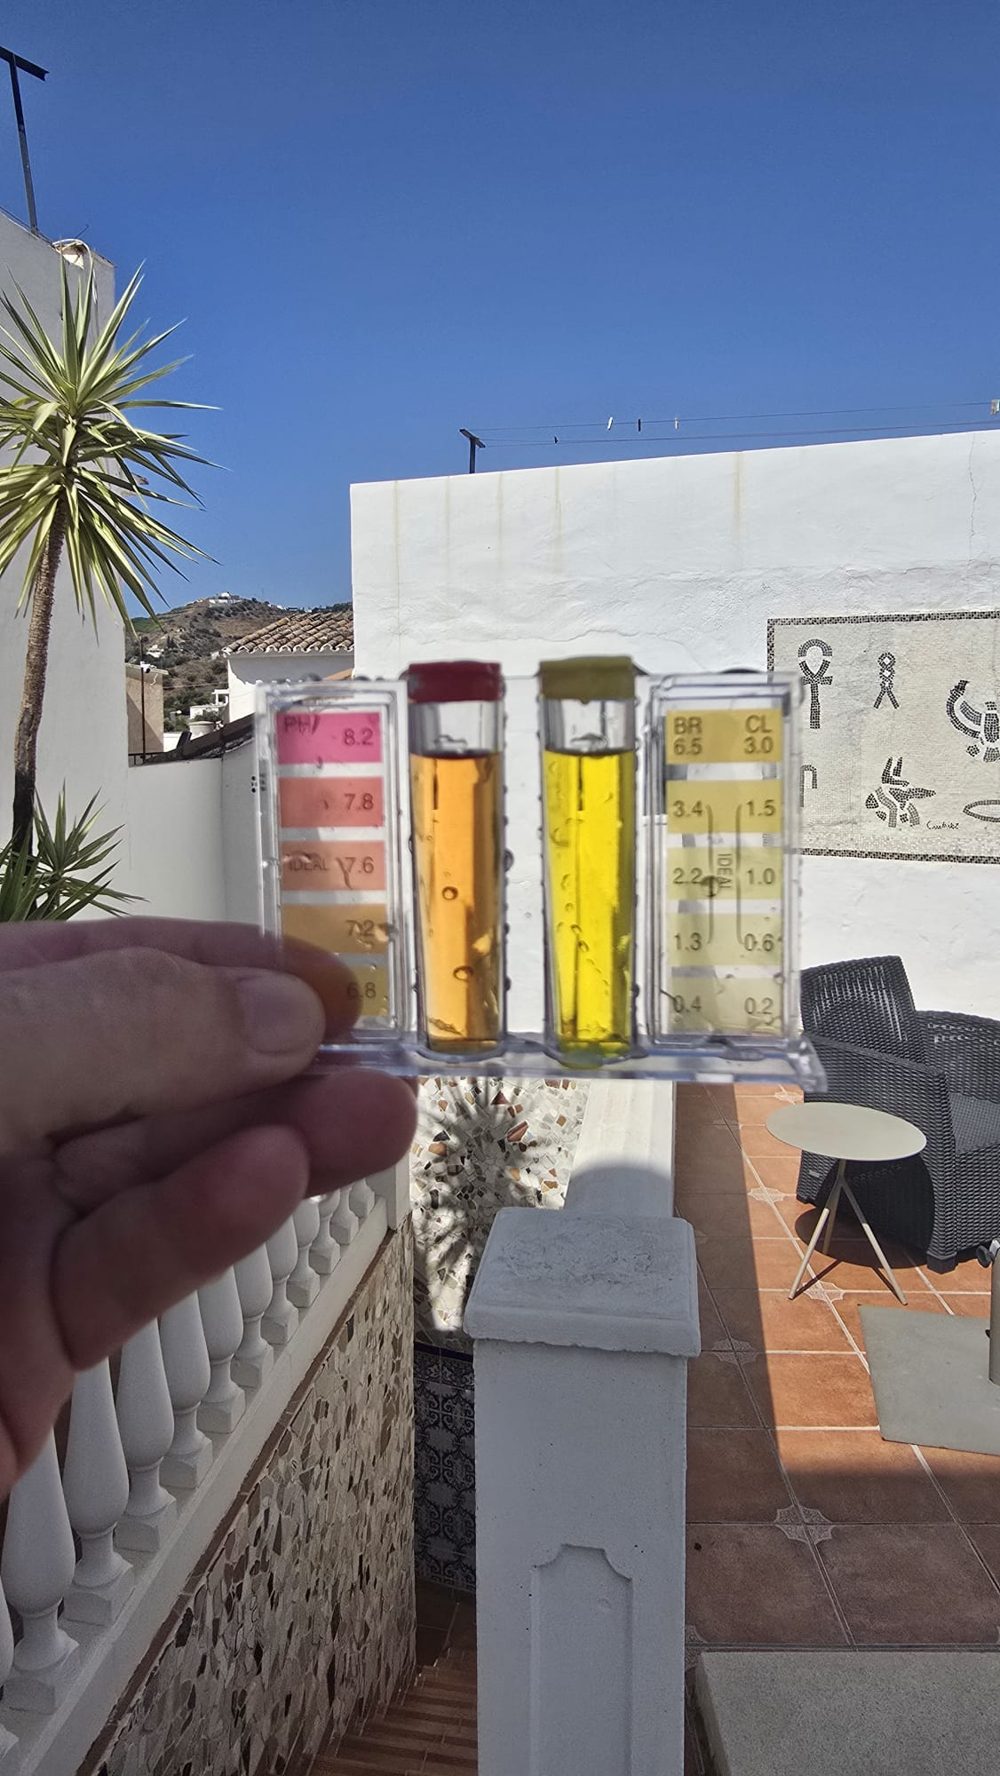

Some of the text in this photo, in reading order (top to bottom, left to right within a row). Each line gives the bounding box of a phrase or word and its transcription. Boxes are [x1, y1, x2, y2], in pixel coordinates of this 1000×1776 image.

[673, 715, 773, 734] BR CL
[343, 728, 374, 746] 8.2
[673, 736, 774, 756] 6.5 3.0
[344, 793, 375, 811] 7.8
[673, 799, 776, 818] 3.4 1.5
[344, 856, 375, 874] 7.6
[717, 853, 733, 888] IDEAL
[672, 867, 776, 885] 2.2 1.0
[674, 932, 774, 952] 1.3 0.6
[346, 981, 376, 999] 6.8
[673, 995, 773, 1015] 0.4 0.2
